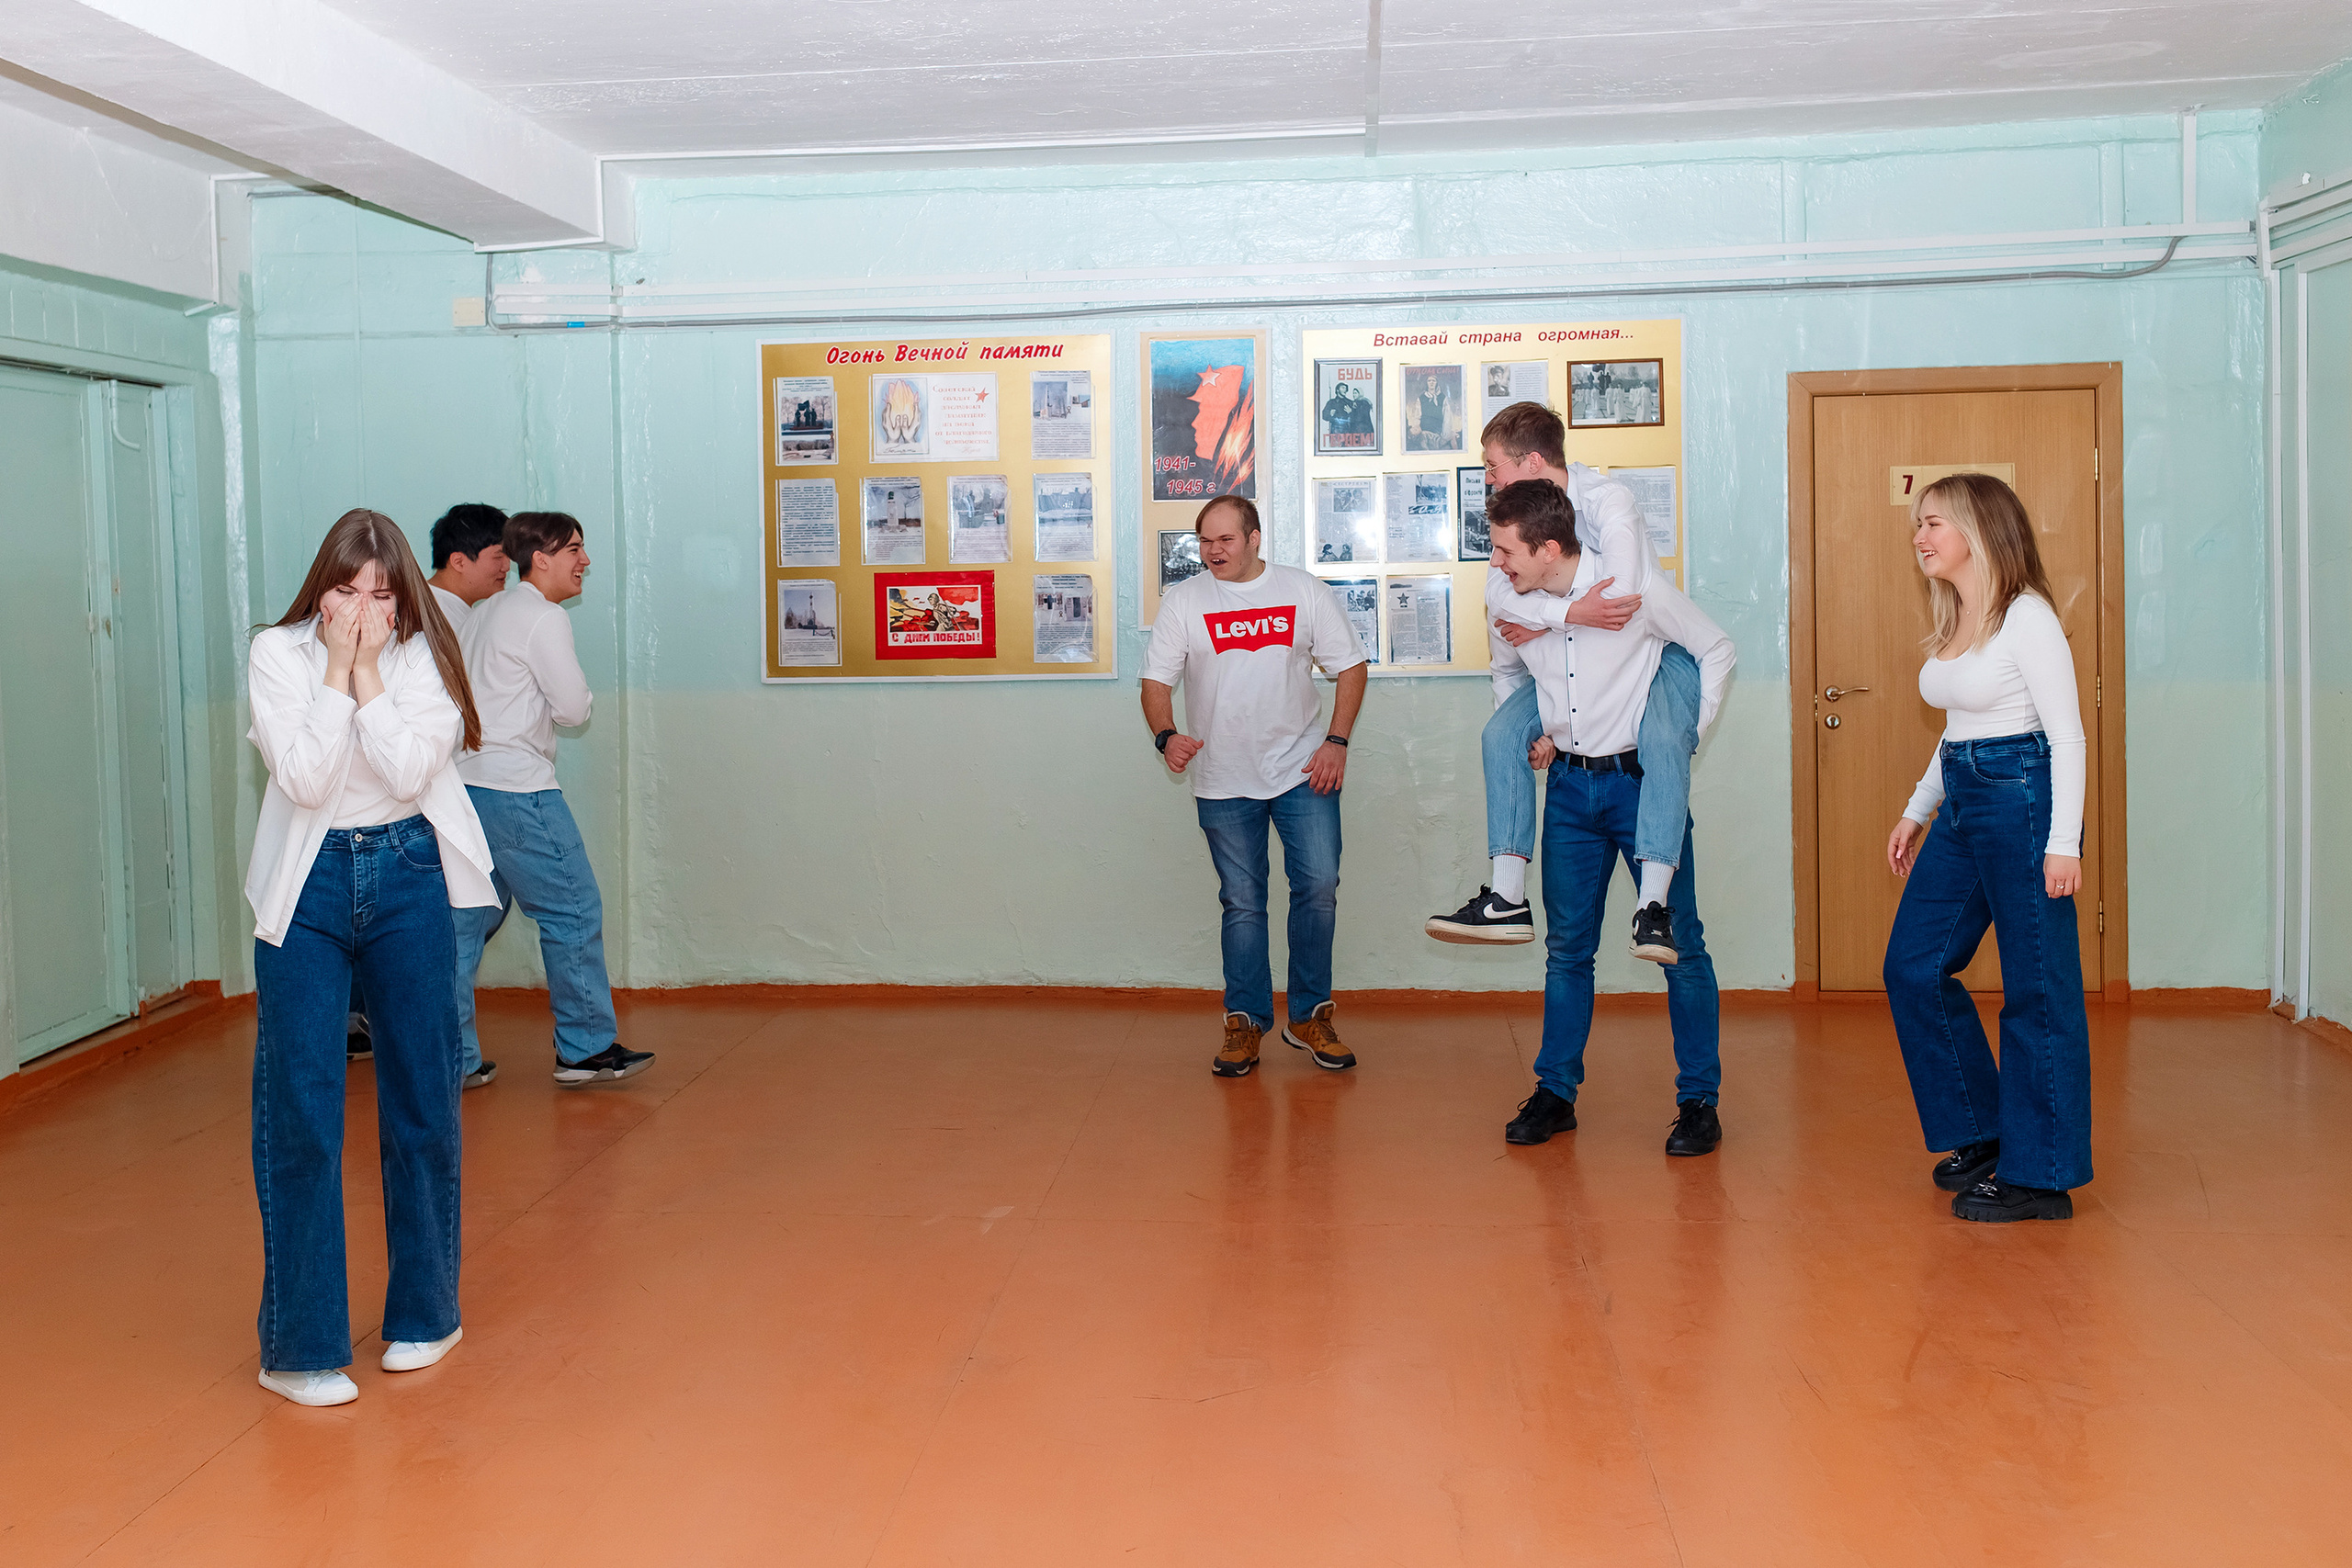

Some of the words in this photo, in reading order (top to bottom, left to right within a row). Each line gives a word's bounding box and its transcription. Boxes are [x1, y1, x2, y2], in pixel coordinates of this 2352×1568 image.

[1374, 331, 1449, 347] Вставай
[1458, 332, 1522, 346] страна
[1538, 329, 1634, 344] огромная...
[826, 345, 886, 365] Огонь
[893, 341, 970, 363] Вечной
[978, 344, 1064, 360] памяти
[1338, 367, 1373, 380] БУДЬ
[1323, 432, 1374, 447] ГЕРОЕМ!
[1155, 456, 1196, 472] 1941-
[1167, 479, 1204, 494] 1945
[1902, 474, 1914, 495] 7
[891, 632, 899, 642] С
[903, 633, 931, 644] ДНЕМ
[933, 632, 980, 643] ПОБЕДЫ!
